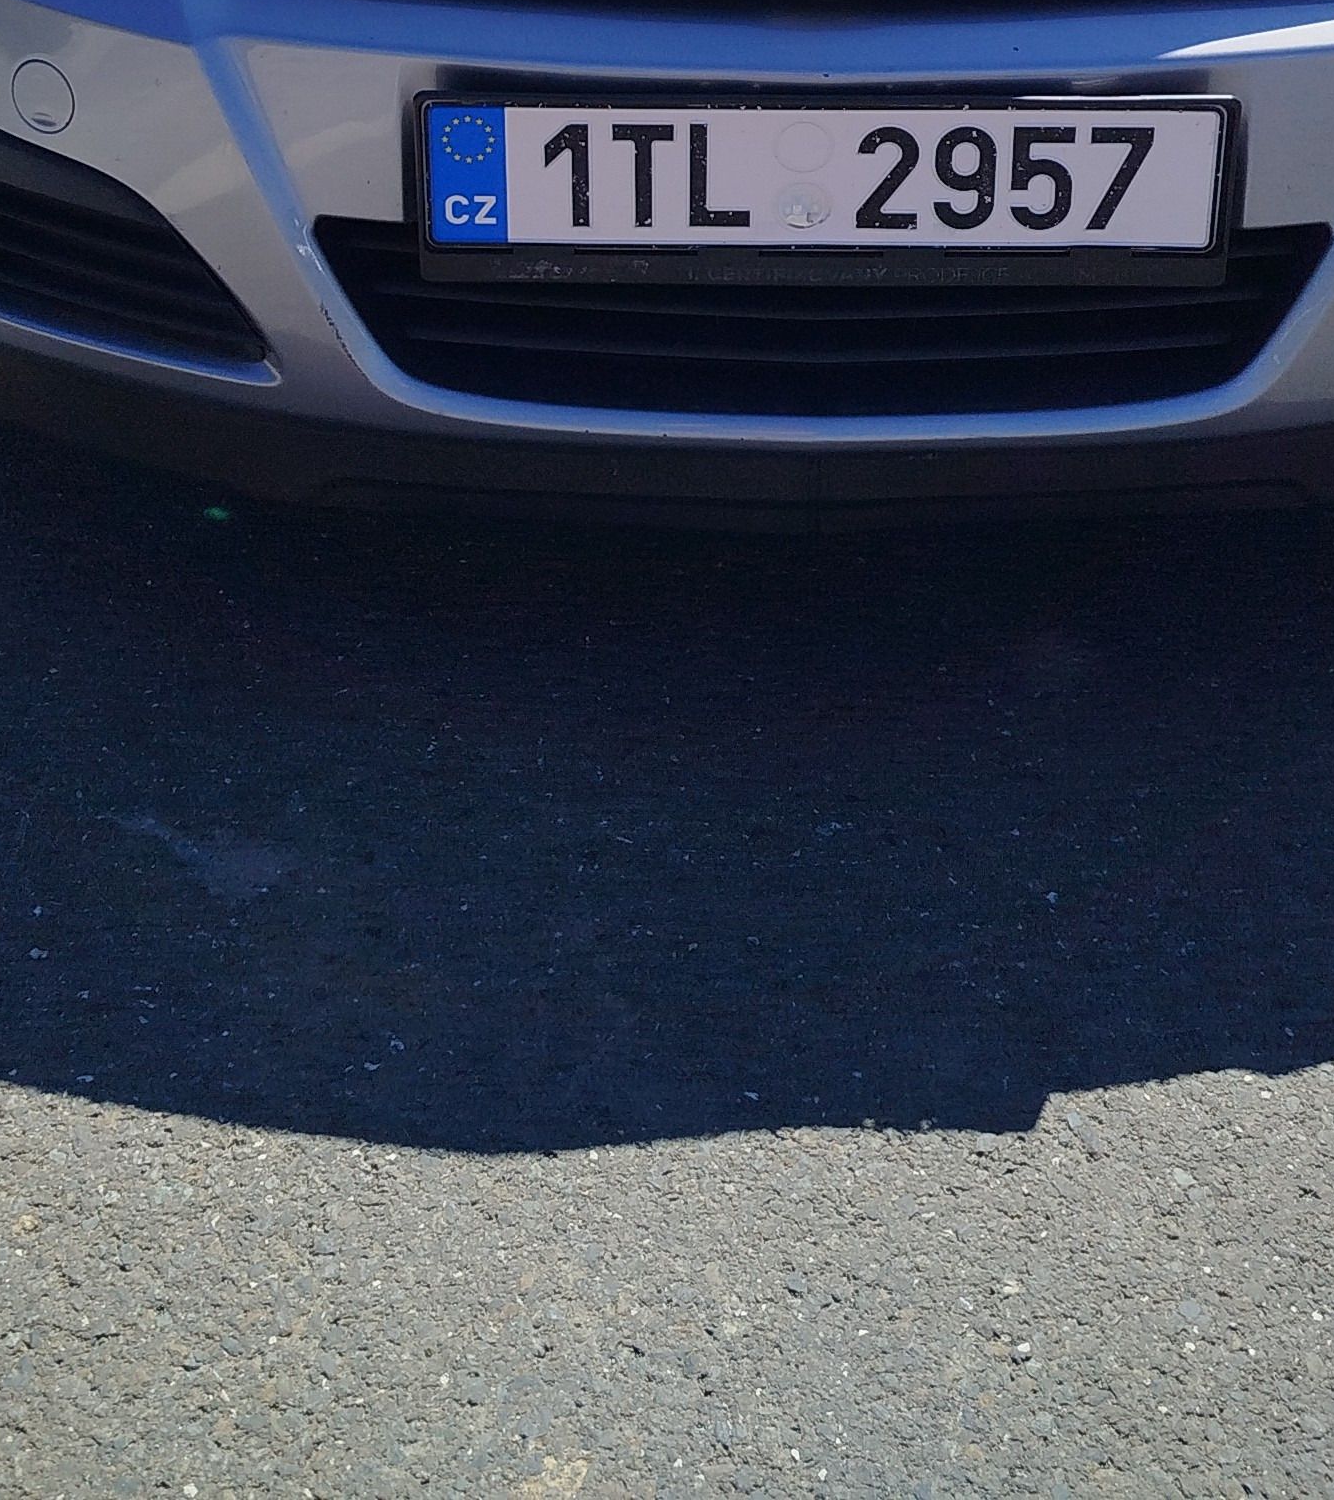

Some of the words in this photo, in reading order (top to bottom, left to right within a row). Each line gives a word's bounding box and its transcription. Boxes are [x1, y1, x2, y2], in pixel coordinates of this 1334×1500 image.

[444, 194, 498, 225] CZ
[544, 123, 751, 228] 1TL
[855, 126, 1156, 231] 2957
